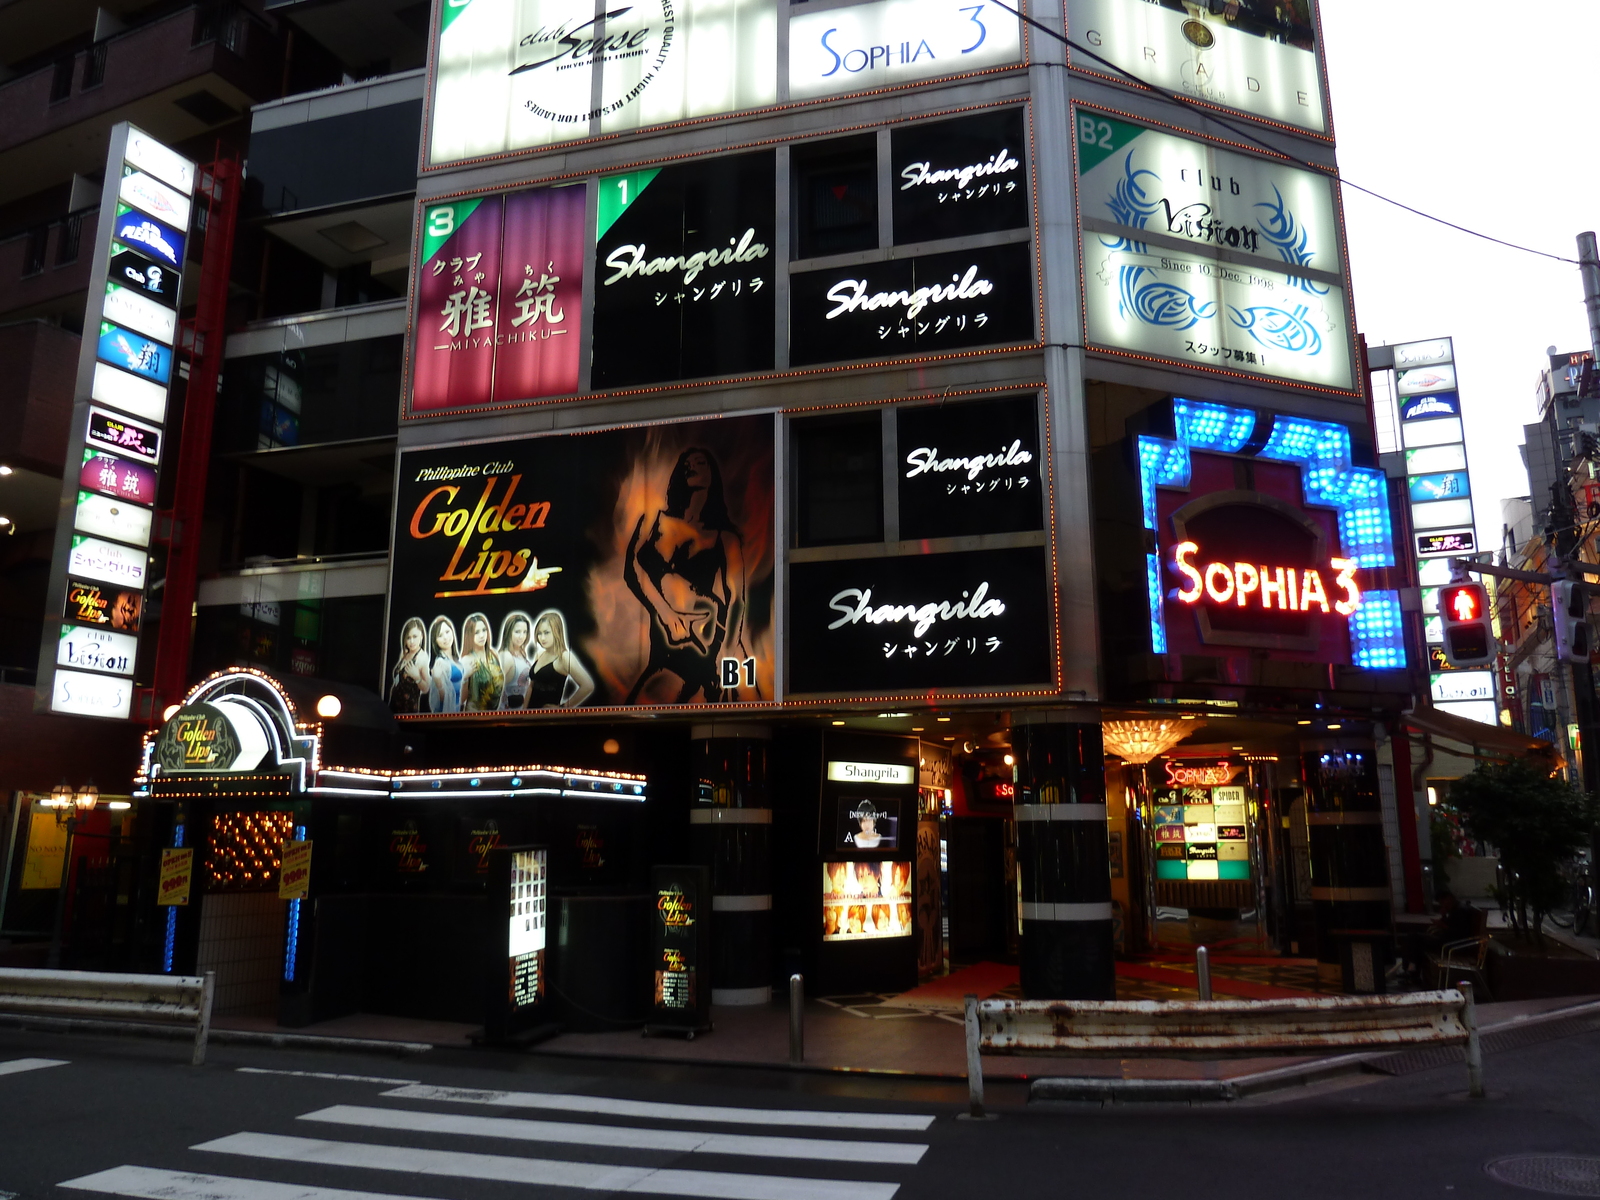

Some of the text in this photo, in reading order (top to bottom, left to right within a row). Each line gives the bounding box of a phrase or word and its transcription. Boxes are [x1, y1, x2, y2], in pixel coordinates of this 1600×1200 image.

[508, 6, 649, 76] club Sense
[653, 25, 675, 72] QUALITY
[821, 4, 987, 77] SOPHIA 3
[615, 49, 649, 60] LUXURY
[524, 99, 555, 122] LADIES
[556, 113, 579, 124] FOR
[1079, 116, 1114, 151] B2
[616, 178, 629, 206] 1
[937, 180, 1018, 203] シャングリラ
[1180, 167, 1240, 196] club
[428, 206, 455, 237] 3
[1158, 197, 1261, 253] Vision
[432, 252, 483, 277] クラブ
[1160, 257, 1192, 274] Since
[1219, 268, 1243, 284] Dec.
[1248, 274, 1276, 291] 1998
[653, 276, 766, 306] シャングリラ
[876, 312, 989, 340] シャングリラ
[415, 459, 515, 483] Philippine Club
[946, 475, 1031, 495] シャングリラ
[409, 474, 552, 540] Golden
[99, 545, 123, 559] Club
[439, 537, 532, 592] Lips
[1174, 540, 1361, 616] SOPHIA 3
[69, 588, 108, 609] Golden
[77, 605, 103, 620] Lips
[882, 636, 1004, 659] シャングリラ
[720, 656, 757, 690] B1
[177, 719, 216, 742] Golden
[185, 741, 211, 761] Lips
[844, 764, 900, 782] Shangrila
[1165, 761, 1230, 785] SOPHIA 3
[1218, 790, 1240, 801] SPIDER
[657, 895, 693, 911] Golden
